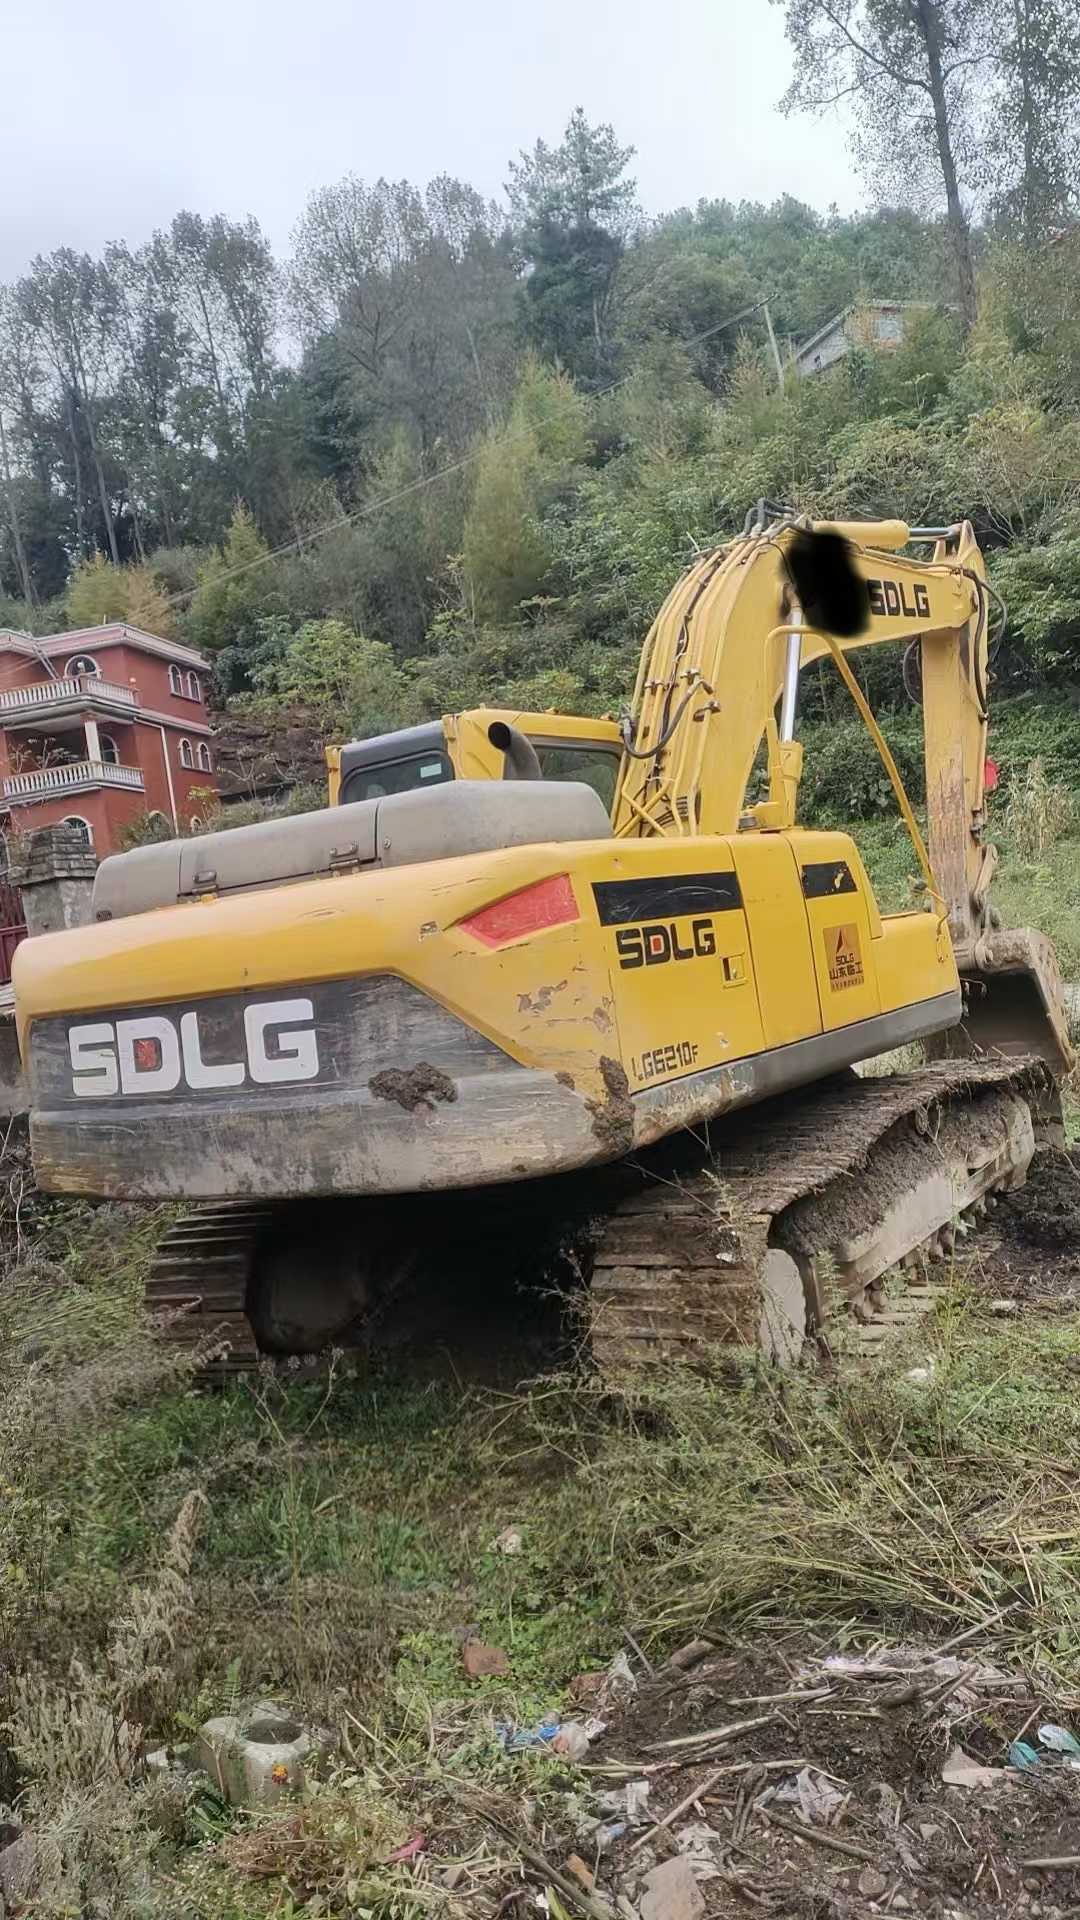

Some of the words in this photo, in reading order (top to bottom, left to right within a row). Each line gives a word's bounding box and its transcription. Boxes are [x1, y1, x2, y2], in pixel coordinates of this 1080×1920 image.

[867, 579, 931, 618] SDLG
[615, 918, 716, 970] SDLG
[829, 961, 864, 980] 山东临工
[68, 998, 319, 1097] SDLG
